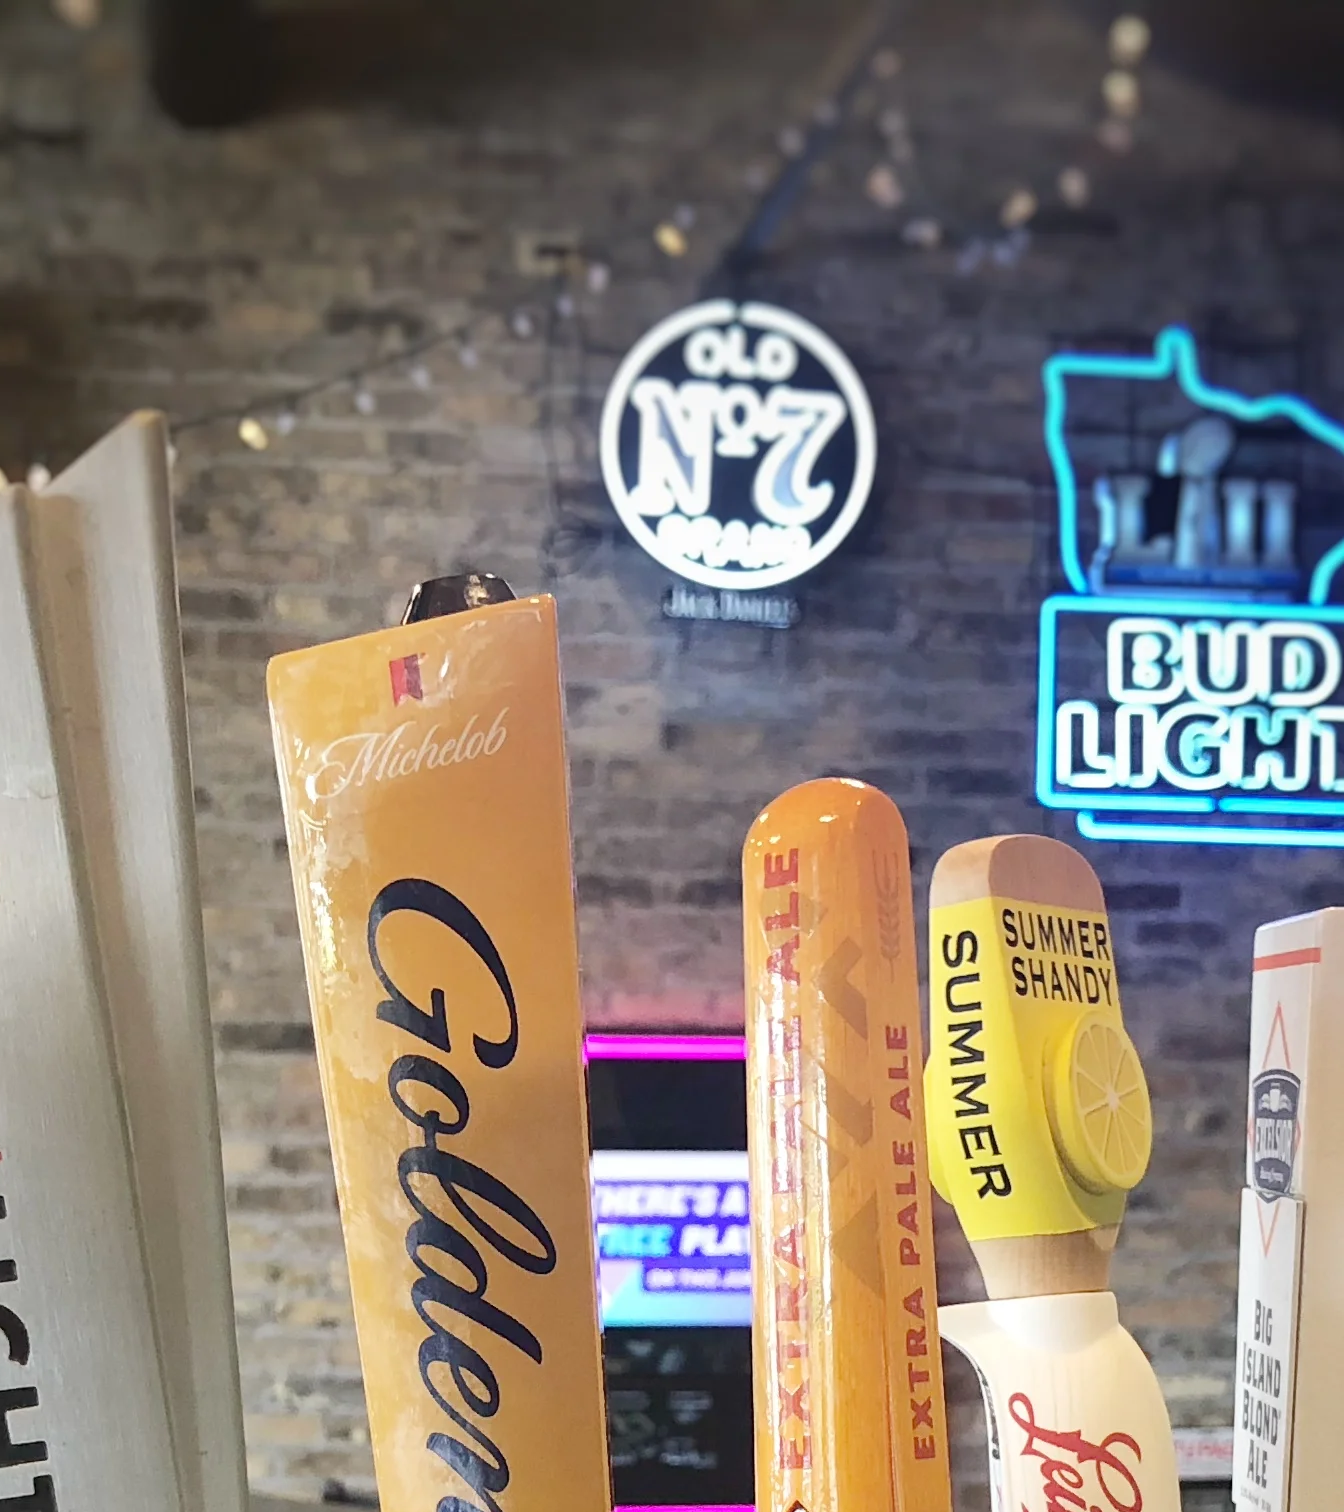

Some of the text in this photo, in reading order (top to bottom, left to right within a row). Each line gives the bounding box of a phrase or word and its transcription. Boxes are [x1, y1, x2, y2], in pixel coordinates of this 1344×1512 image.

[683, 324, 799, 382] OLD
[1107, 617, 1341, 706] BUD
[310, 707, 509, 800] Michelob
[763, 848, 802, 987] ALE
[1002, 908, 1111, 961] SUMMER
[1011, 956, 1113, 1006] SHANDY
[942, 929, 1013, 1200] SUMMER
[596, 1185, 720, 1218] HERE'S
[885, 1024, 937, 1461] EXTRA PALE ALE
[773, 1220, 813, 1470] EXTRA
[1253, 1298, 1273, 1347] BIG
[1242, 1341, 1282, 1399] ISLAND
[1241, 1388, 1280, 1446] BLOND
[1246, 1438, 1268, 1489] ALE
